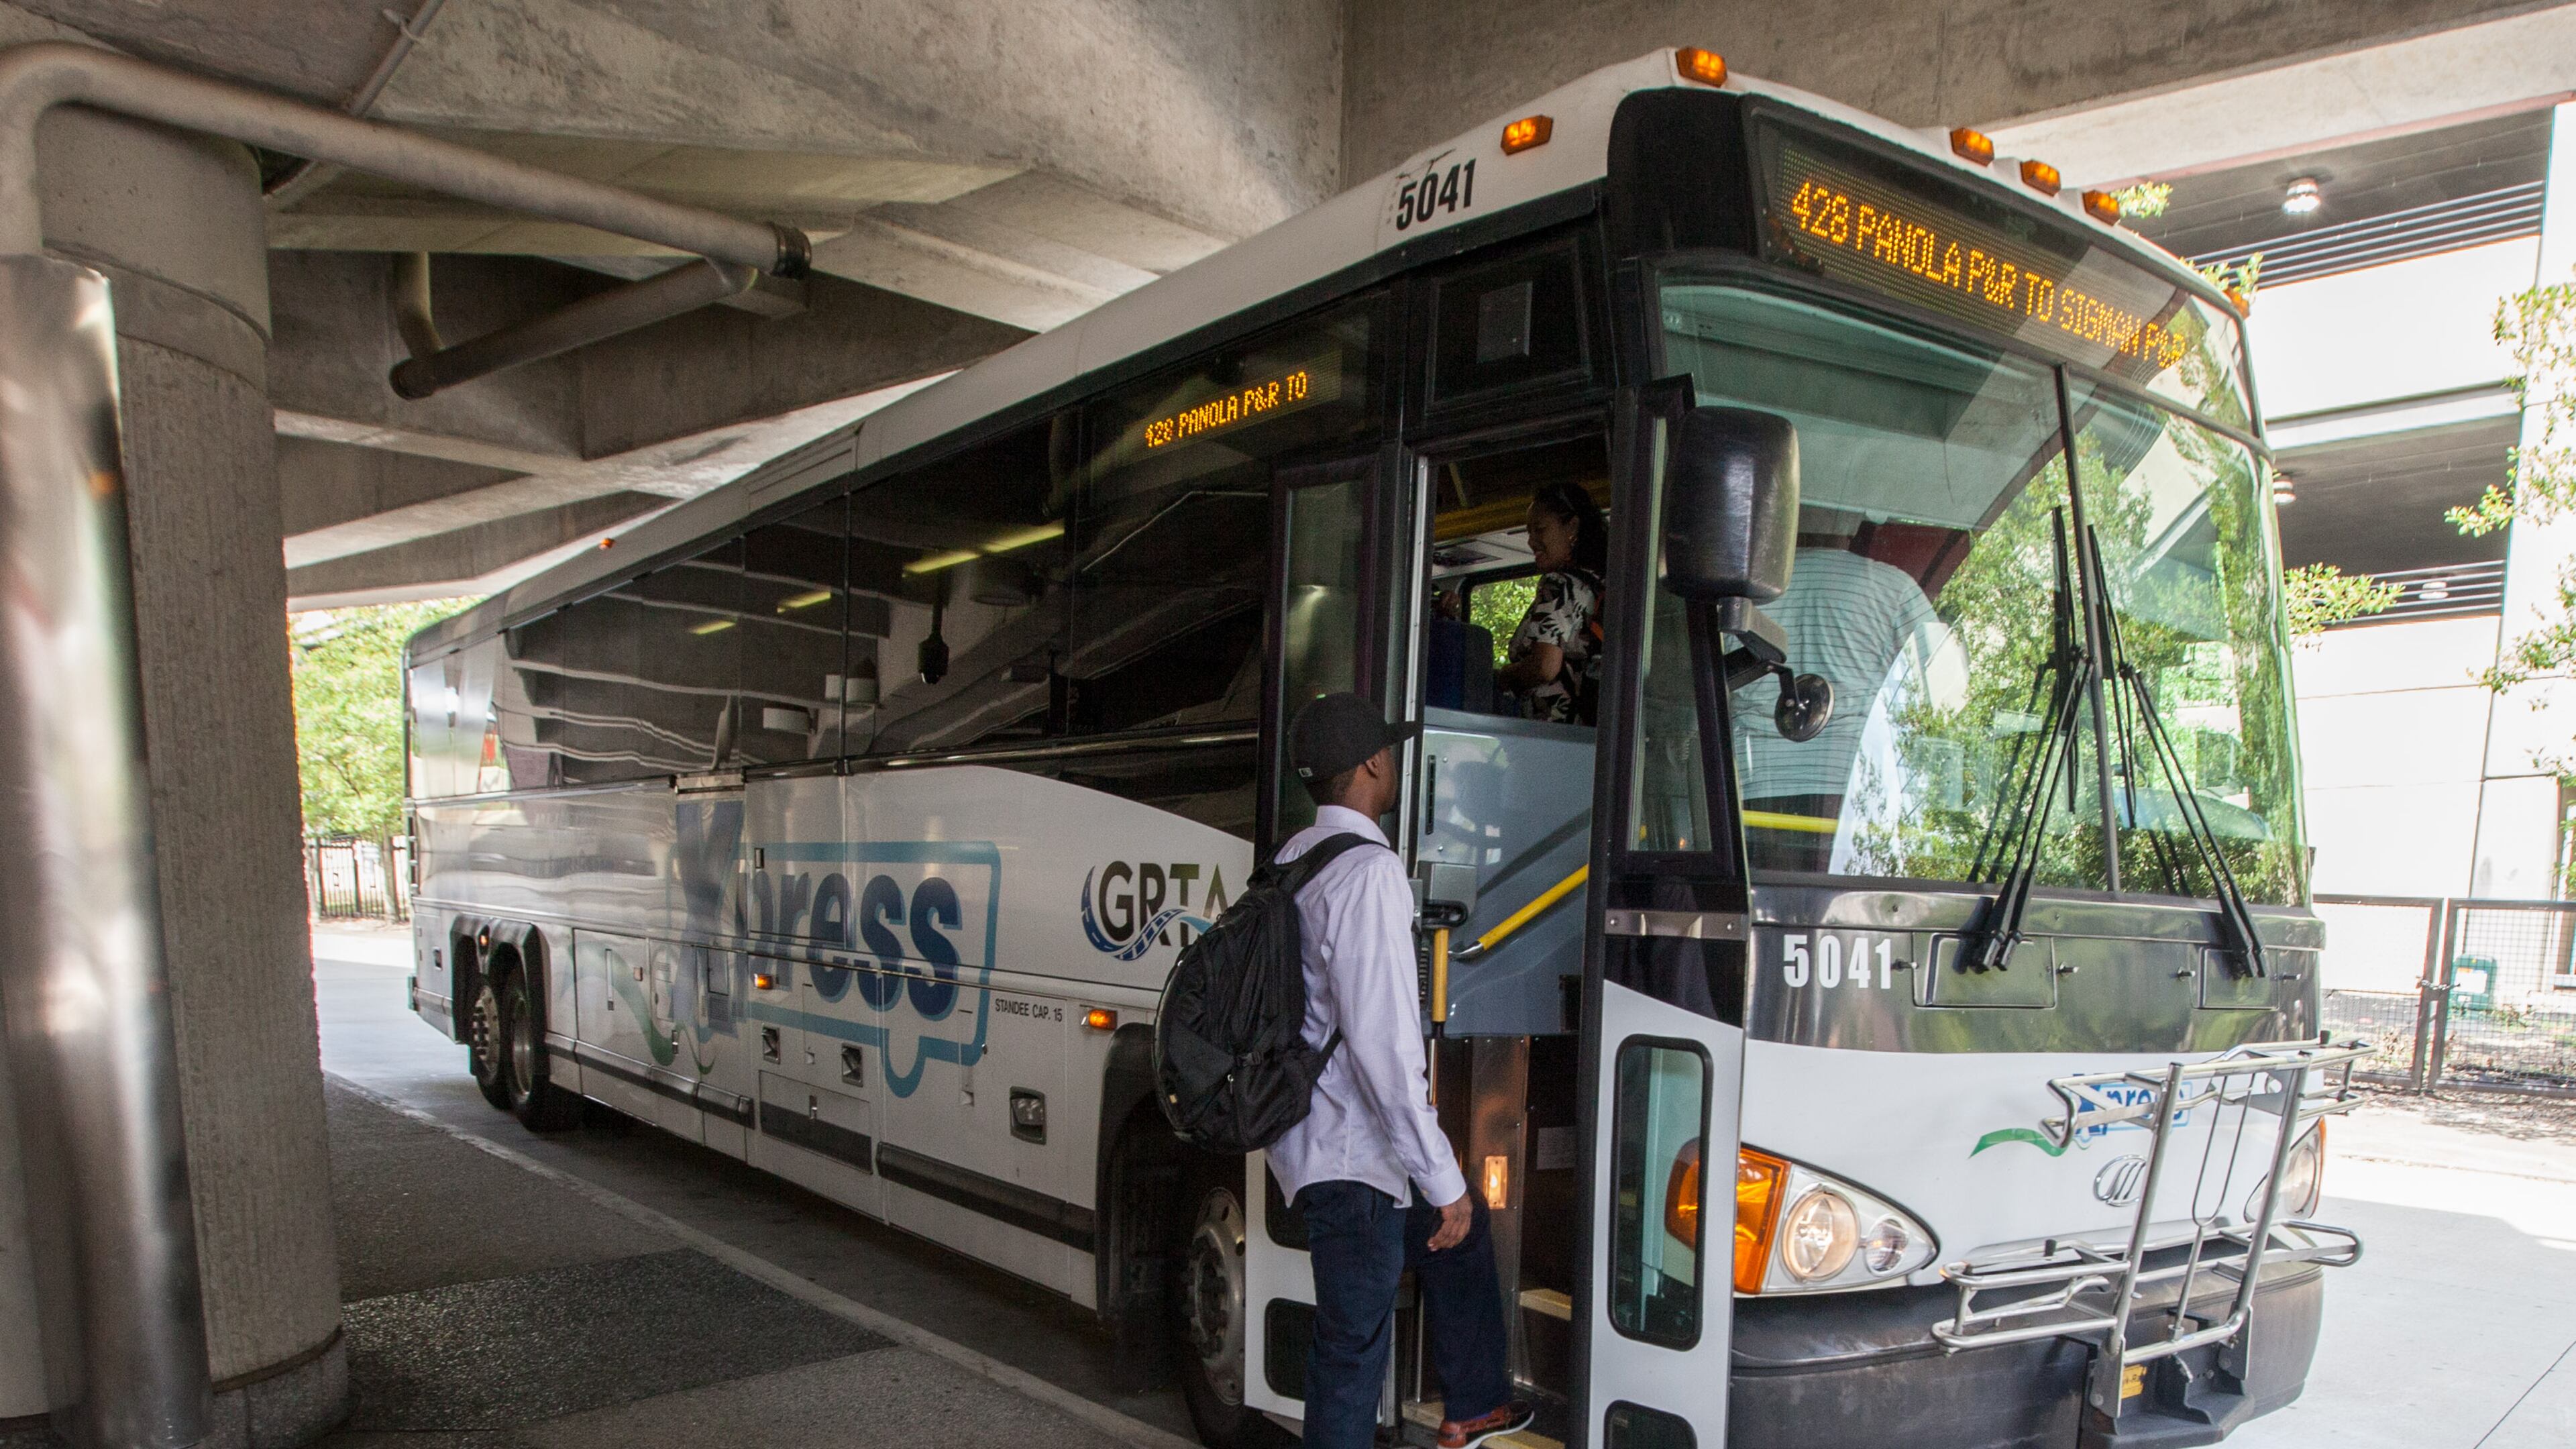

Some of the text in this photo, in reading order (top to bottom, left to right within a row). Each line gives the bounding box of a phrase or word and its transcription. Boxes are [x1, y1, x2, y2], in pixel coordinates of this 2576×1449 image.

[1396, 158, 1476, 230] 5041
[1792, 182, 1849, 244] 428
[1856, 205, 1961, 287] PANOLA
[1967, 249, 2017, 309] P&R
[2025, 272, 2055, 322] TO
[2059, 288, 2142, 357] SIGMAN
[1145, 371, 1307, 447] 428 PANOLA P&R TO
[1098, 860, 1229, 947] GRTA
[1783, 933, 1891, 989] 5041
[995, 998, 1063, 1022] STANDEE CAP. 15
